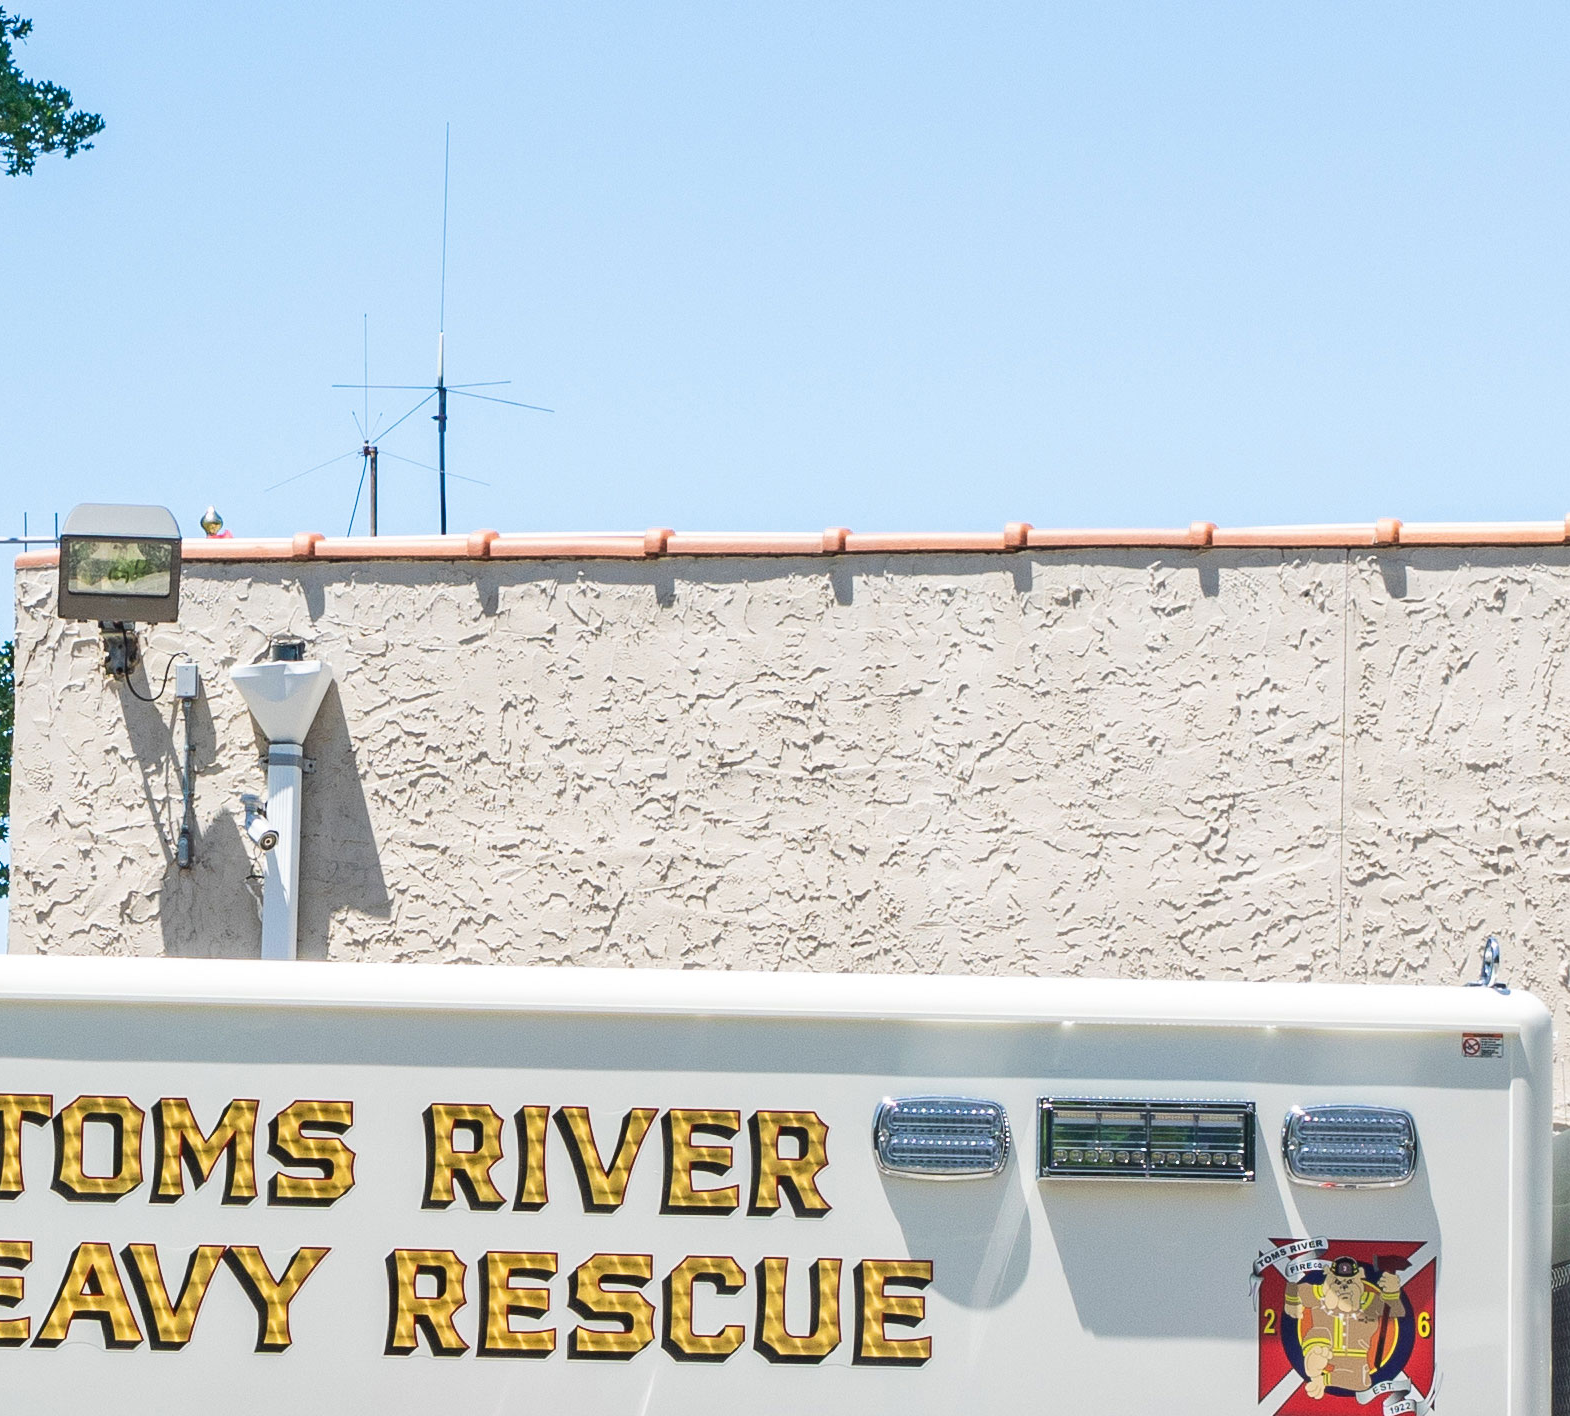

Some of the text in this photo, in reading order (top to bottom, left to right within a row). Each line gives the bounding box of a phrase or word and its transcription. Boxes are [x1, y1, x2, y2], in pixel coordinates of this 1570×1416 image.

[421, 1101, 832, 1219] RIVER
[1256, 1238, 1324, 1268] TOMS RIVER
[1289, 1261, 1312, 1274] FIRE
[383, 1248, 934, 1368] RESCUE
[1263, 1308, 1276, 1334] 2
[1417, 1311, 1431, 1338] 6
[1389, 1402, 1412, 1414] 1922
